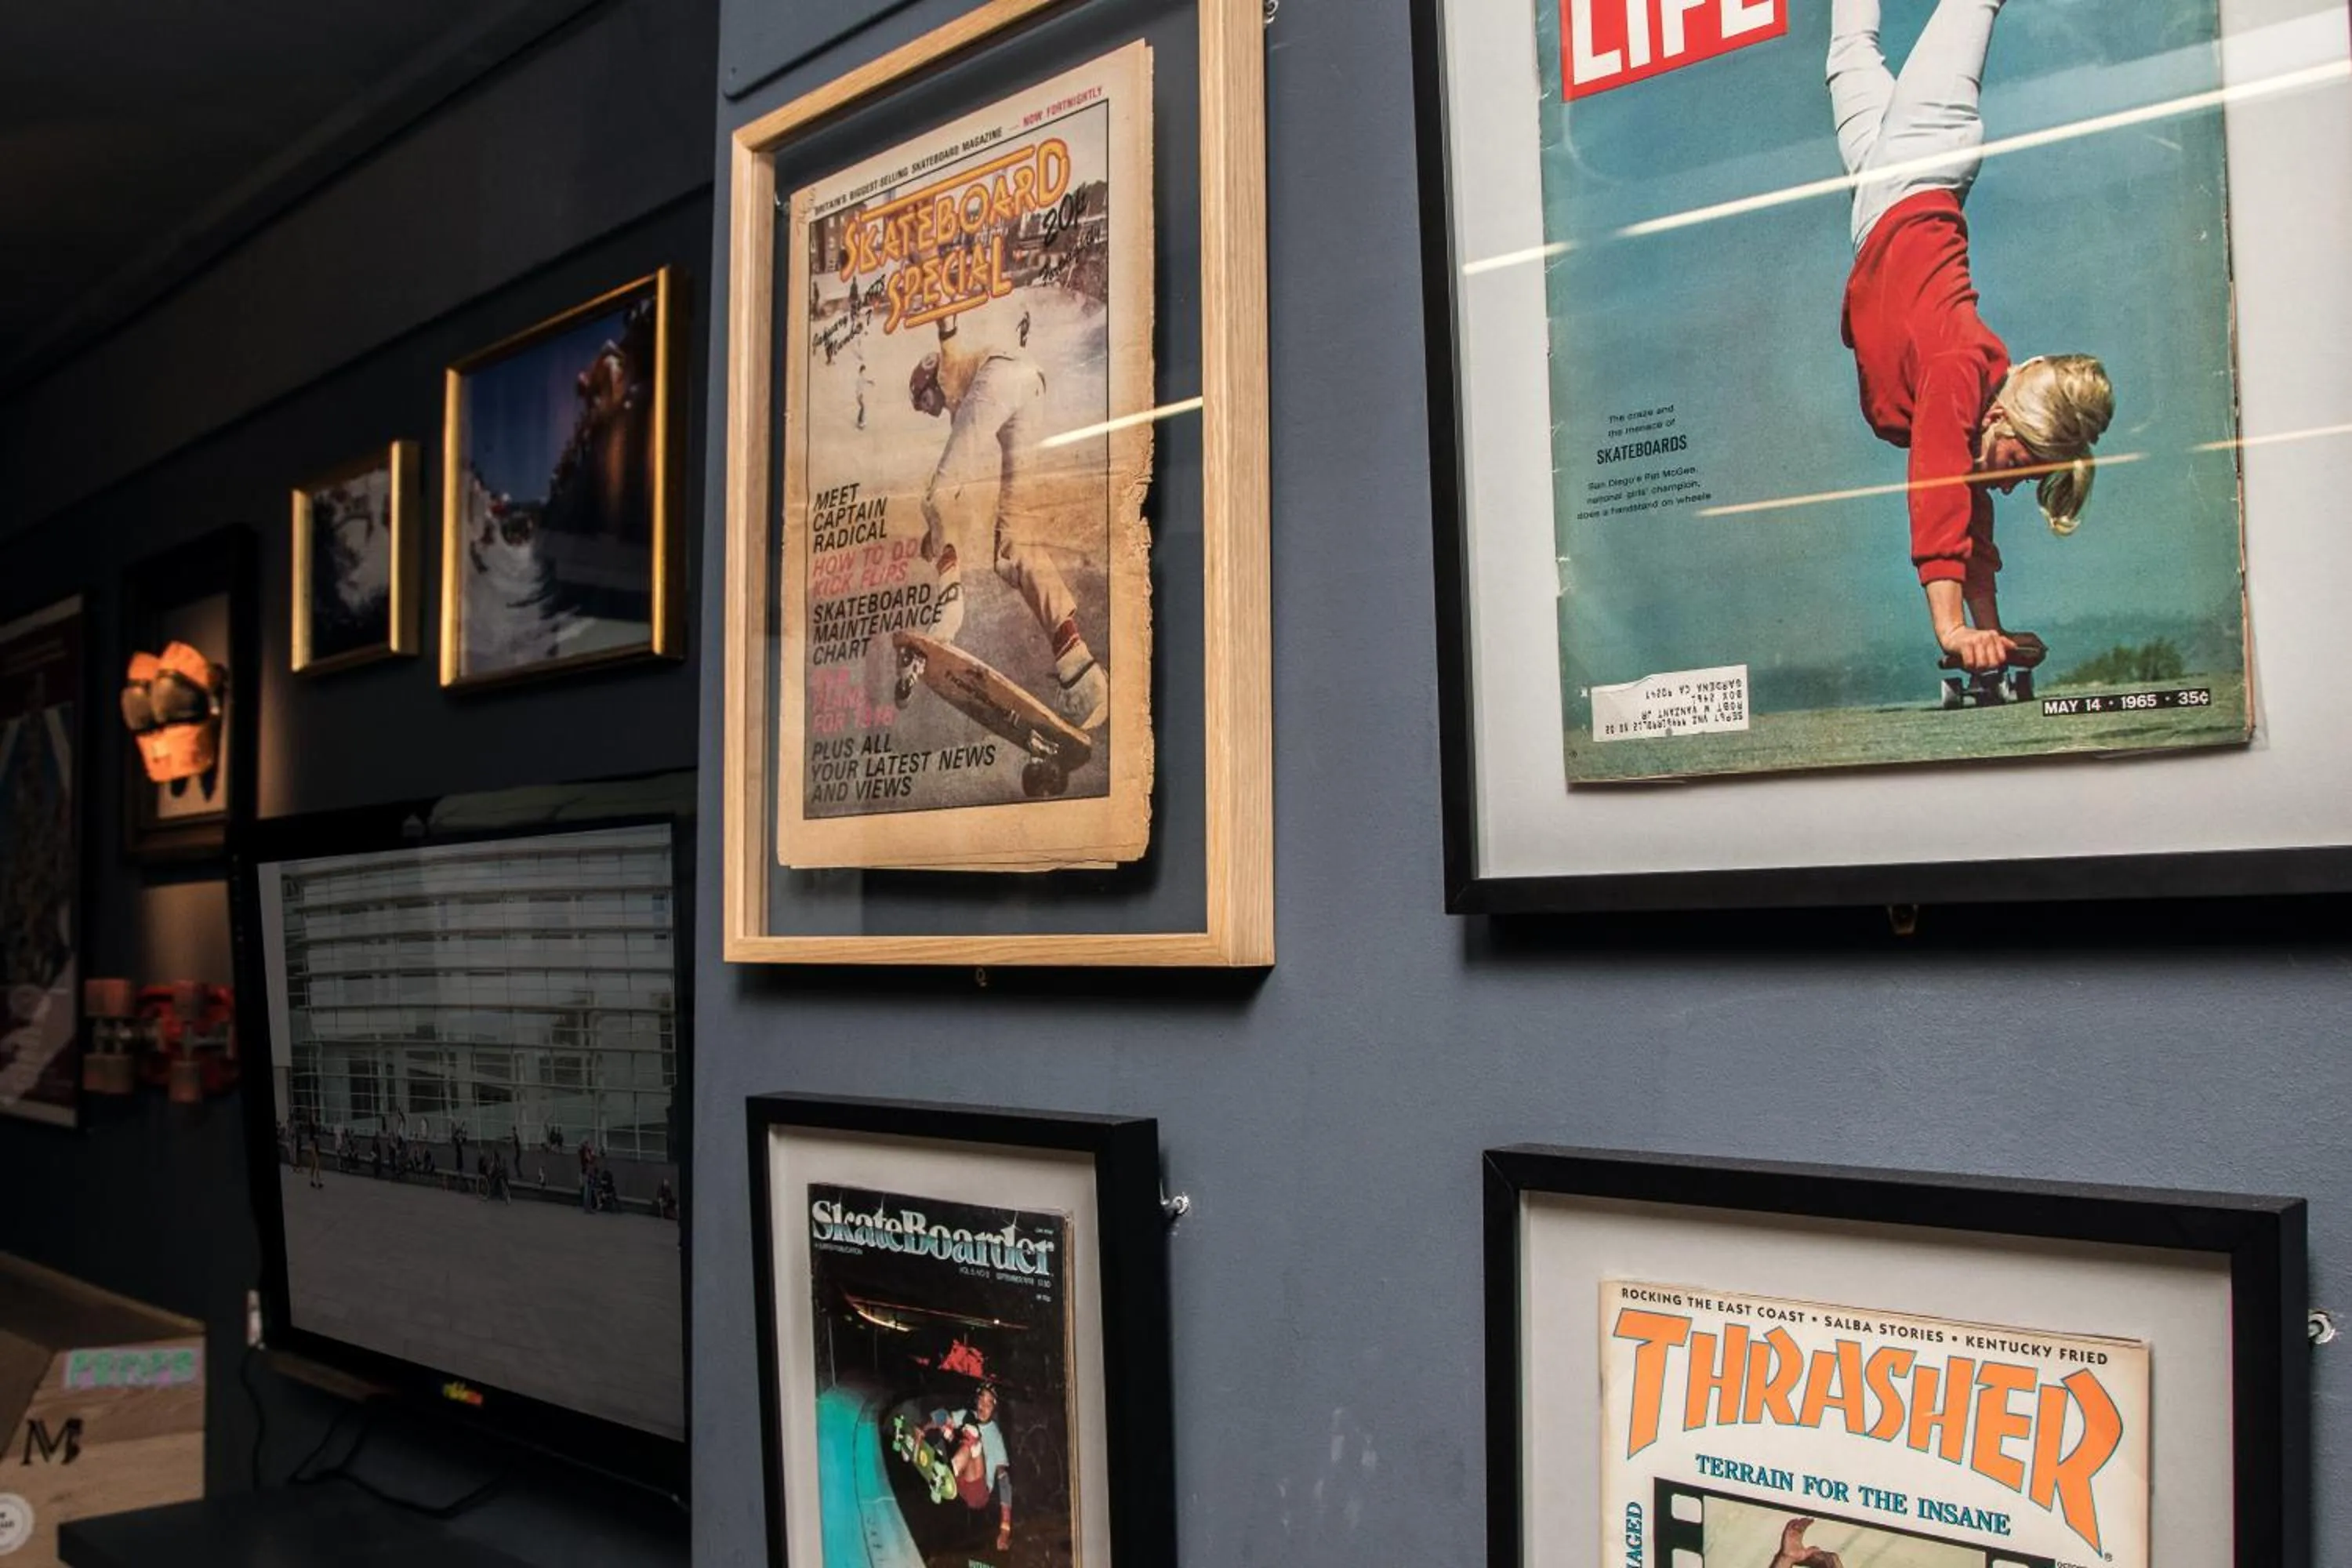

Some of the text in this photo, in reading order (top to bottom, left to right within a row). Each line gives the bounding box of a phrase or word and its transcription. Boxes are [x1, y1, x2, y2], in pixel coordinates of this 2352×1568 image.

[912, 145, 959, 173] SKATEBOARD
[962, 126, 1003, 151] MAGAZINE
[1023, 113, 1043, 127] NOW
[1046, 86, 1103, 118] FORTNIGHTLY
[839, 138, 1070, 282] SKATEBOARD
[884, 234, 1014, 336] SPECIAL
[1608, 418, 1676, 437] the menace of
[1610, 405, 1675, 424] The craze and
[1597, 434, 1688, 465] SKATEBOARDS
[813, 483, 861, 512] MEET
[1586, 492, 1622, 504] national
[1651, 480, 1700, 495] champion,
[1588, 481, 1606, 491] San
[813, 497, 887, 532] CAPTAIN
[1577, 510, 1600, 520] does
[1610, 500, 1659, 515] handstand
[1661, 499, 1674, 507] on
[813, 519, 888, 554] RADICAL
[812, 539, 918, 578] HOW TO DO
[812, 561, 909, 597] KICK FLIPS
[813, 583, 931, 625] SKATEBOARD
[812, 603, 942, 645] MAINTENANCE
[812, 637, 873, 666] CHART
[1679, 686, 1691, 696] CA
[1697, 678, 1742, 693] GARDENA
[1722, 690, 1743, 702] BOX
[2045, 699, 2079, 715] MAY
[2084, 698, 2102, 712] 14
[2121, 694, 2157, 710] 1965
[812, 712, 847, 734] FOR
[811, 733, 892, 761] PLUS ALL
[811, 744, 996, 783] YOUR LATEST NEWS
[811, 775, 913, 805] AND VIEWS
[811, 1200, 1055, 1276] SkateBoarder
[1622, 1287, 2109, 1366] ROCKING THE EAST COAST SALBA STORIES KENTUCKY FRIED
[1613, 1307, 2125, 1558] THRASHER
[1695, 1453, 2011, 1537] TERRAIN FOR THE INSANE
[1625, 1501, 1642, 1568] AGED
